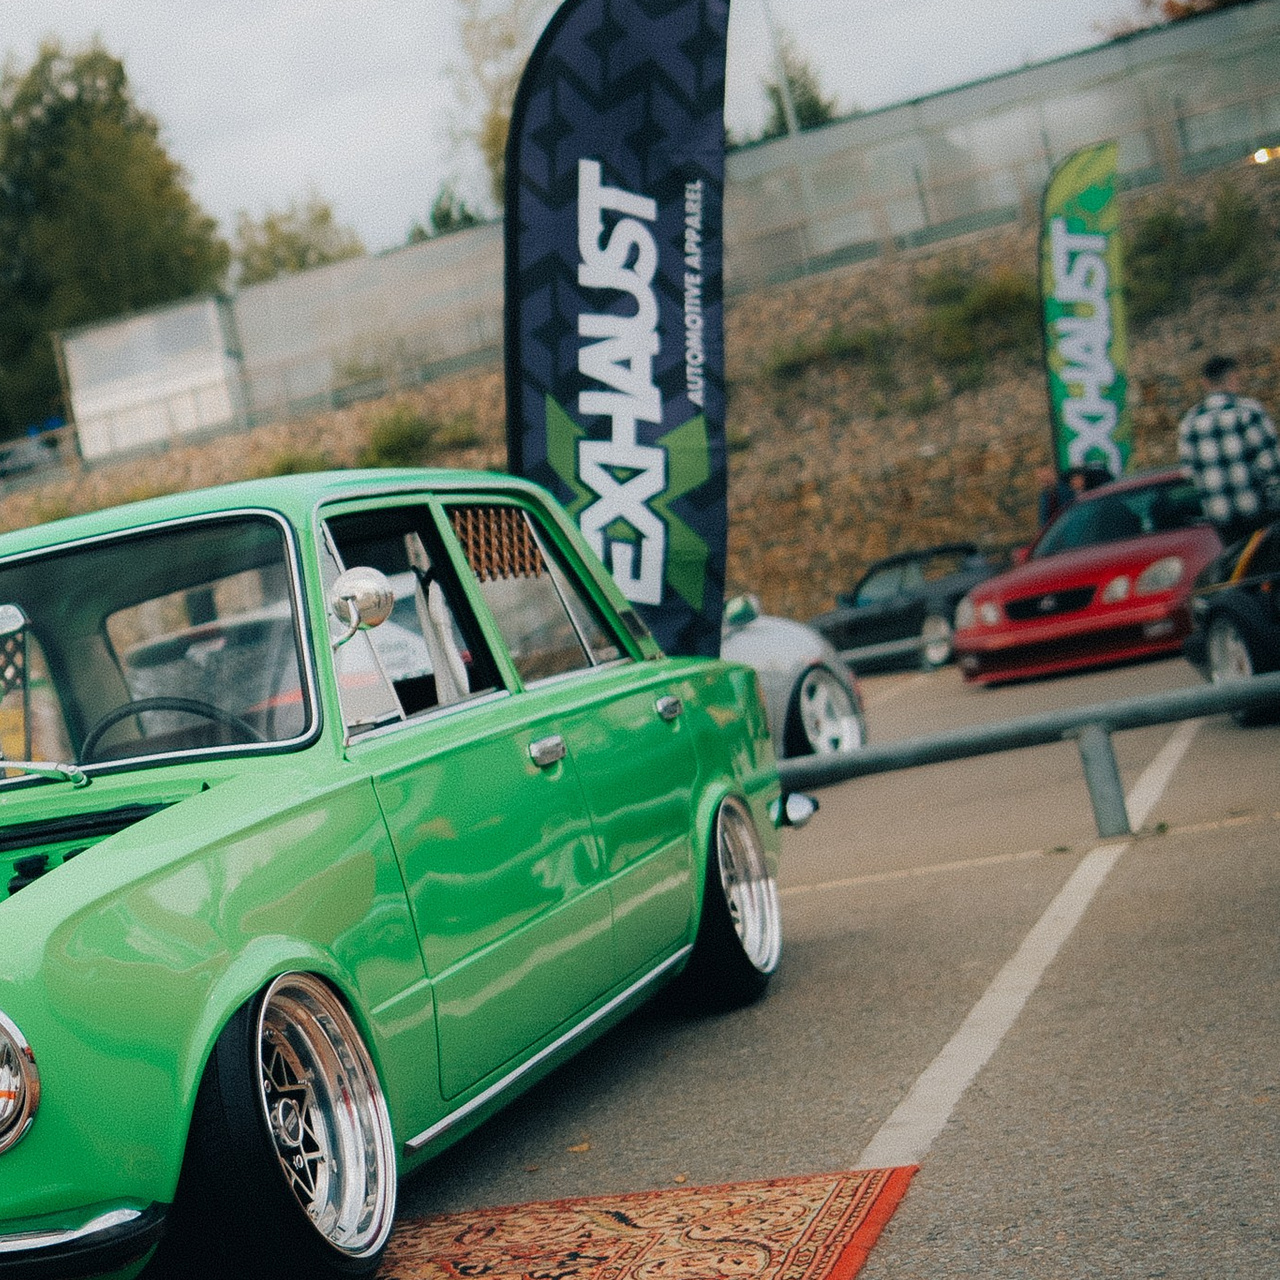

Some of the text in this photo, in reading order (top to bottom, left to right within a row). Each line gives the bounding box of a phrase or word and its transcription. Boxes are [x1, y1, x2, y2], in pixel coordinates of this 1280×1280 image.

[577, 158, 665, 605] EXHAUST
[684, 179, 705, 407] AUTOMOTIVE APPAREL
